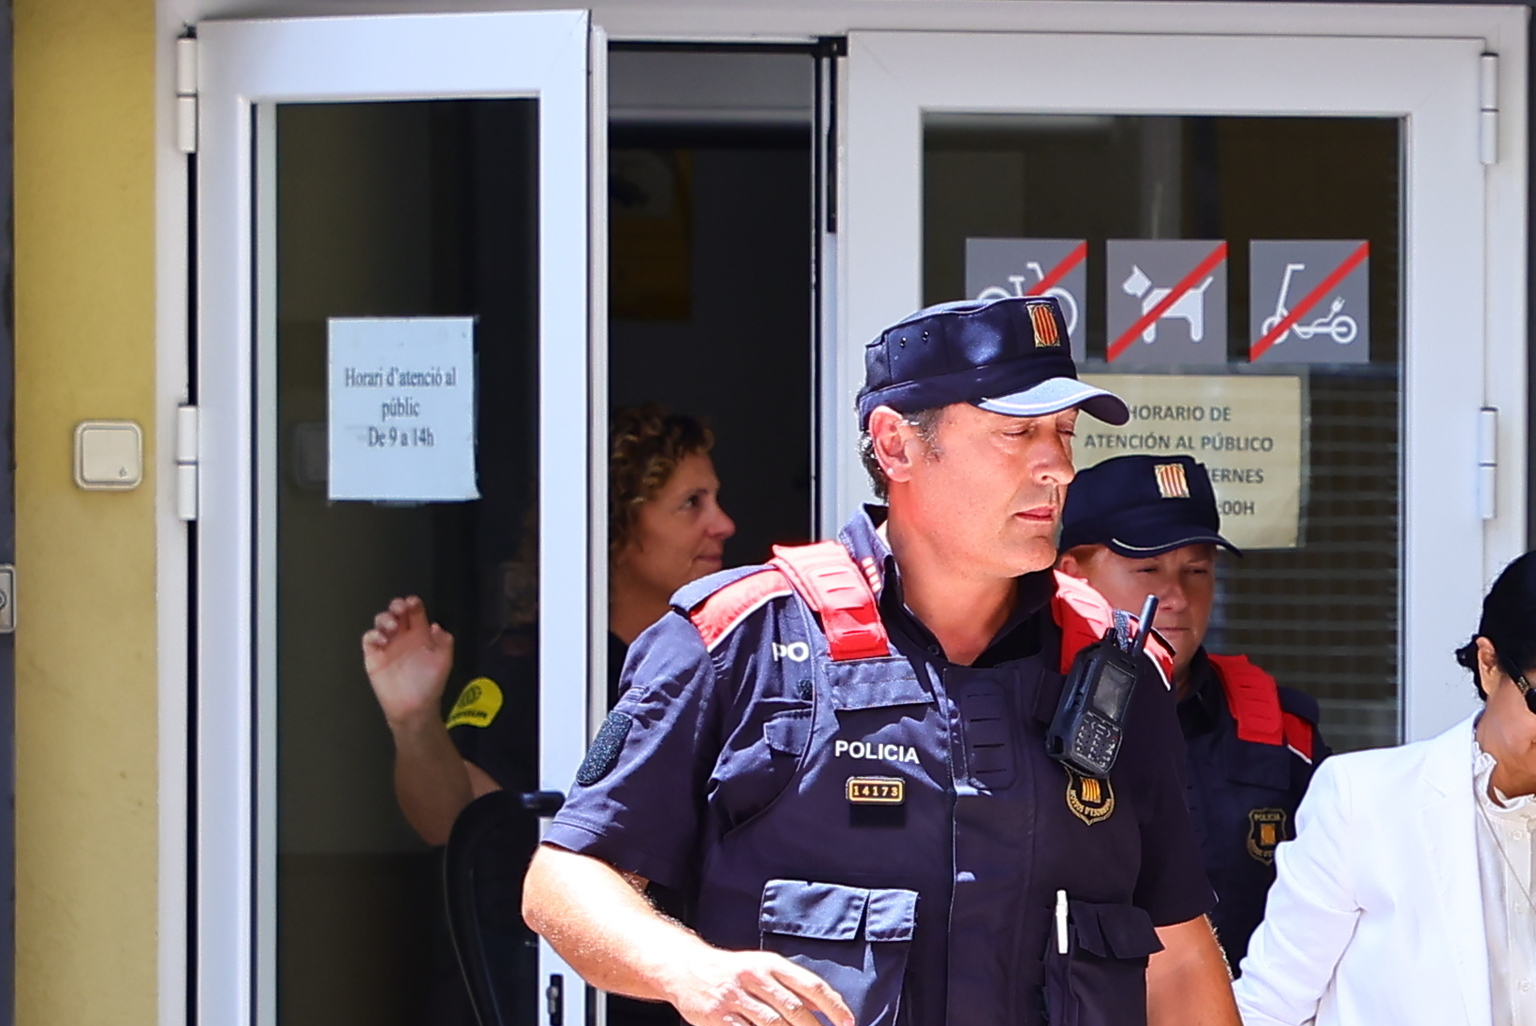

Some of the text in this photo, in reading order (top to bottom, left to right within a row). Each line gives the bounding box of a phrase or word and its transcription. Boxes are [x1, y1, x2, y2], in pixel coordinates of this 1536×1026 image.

[345, 366, 457, 387] Horari d'atenció al
[381, 397, 420, 422] públic
[1210, 406, 1232, 422] DE
[368, 426, 435, 447] De 9 a 14h
[1085, 432, 1274, 451] ATENCIÓN AL PÚBLICO
[1211, 468, 1264, 484] ERNES
[835, 740, 921, 764] POLICIA
[853, 785, 899, 797] 14173
